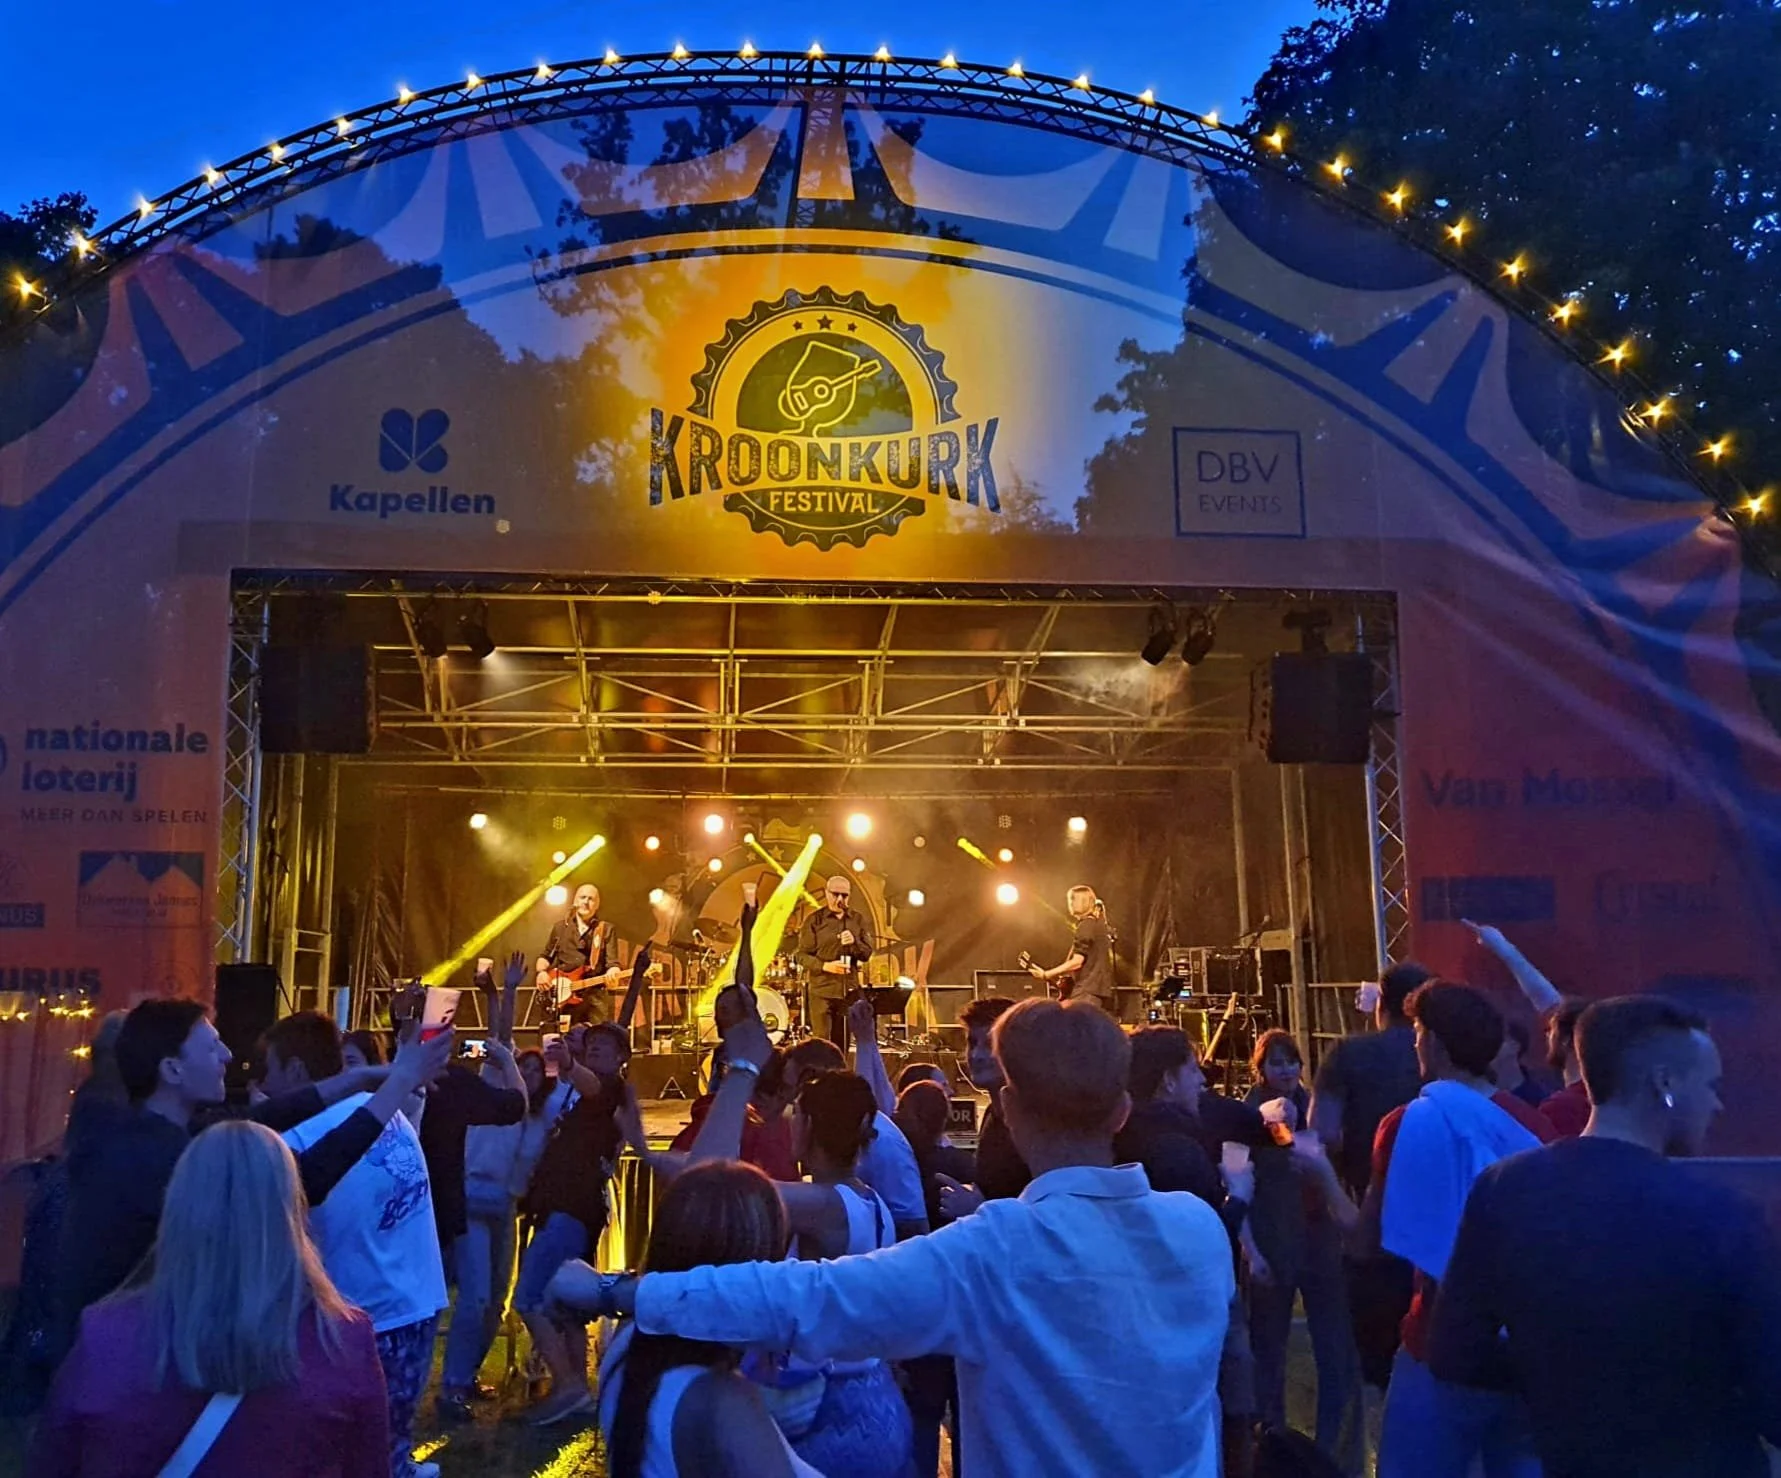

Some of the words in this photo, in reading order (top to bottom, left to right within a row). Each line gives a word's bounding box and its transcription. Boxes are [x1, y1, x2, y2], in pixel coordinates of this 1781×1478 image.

[649, 407, 1001, 514] KROONKURK
[1197, 450, 1279, 484] DBV
[329, 484, 496, 519] Kapellen
[768, 490, 880, 514] FESTIVAL
[1199, 494, 1283, 514] EVENTS
[25, 719, 210, 753] nationale
[21, 760, 138, 803] loterij
[20, 807, 74, 824] MEER
[81, 808, 124, 823] DAN
[131, 808, 208, 824] SPELEN
